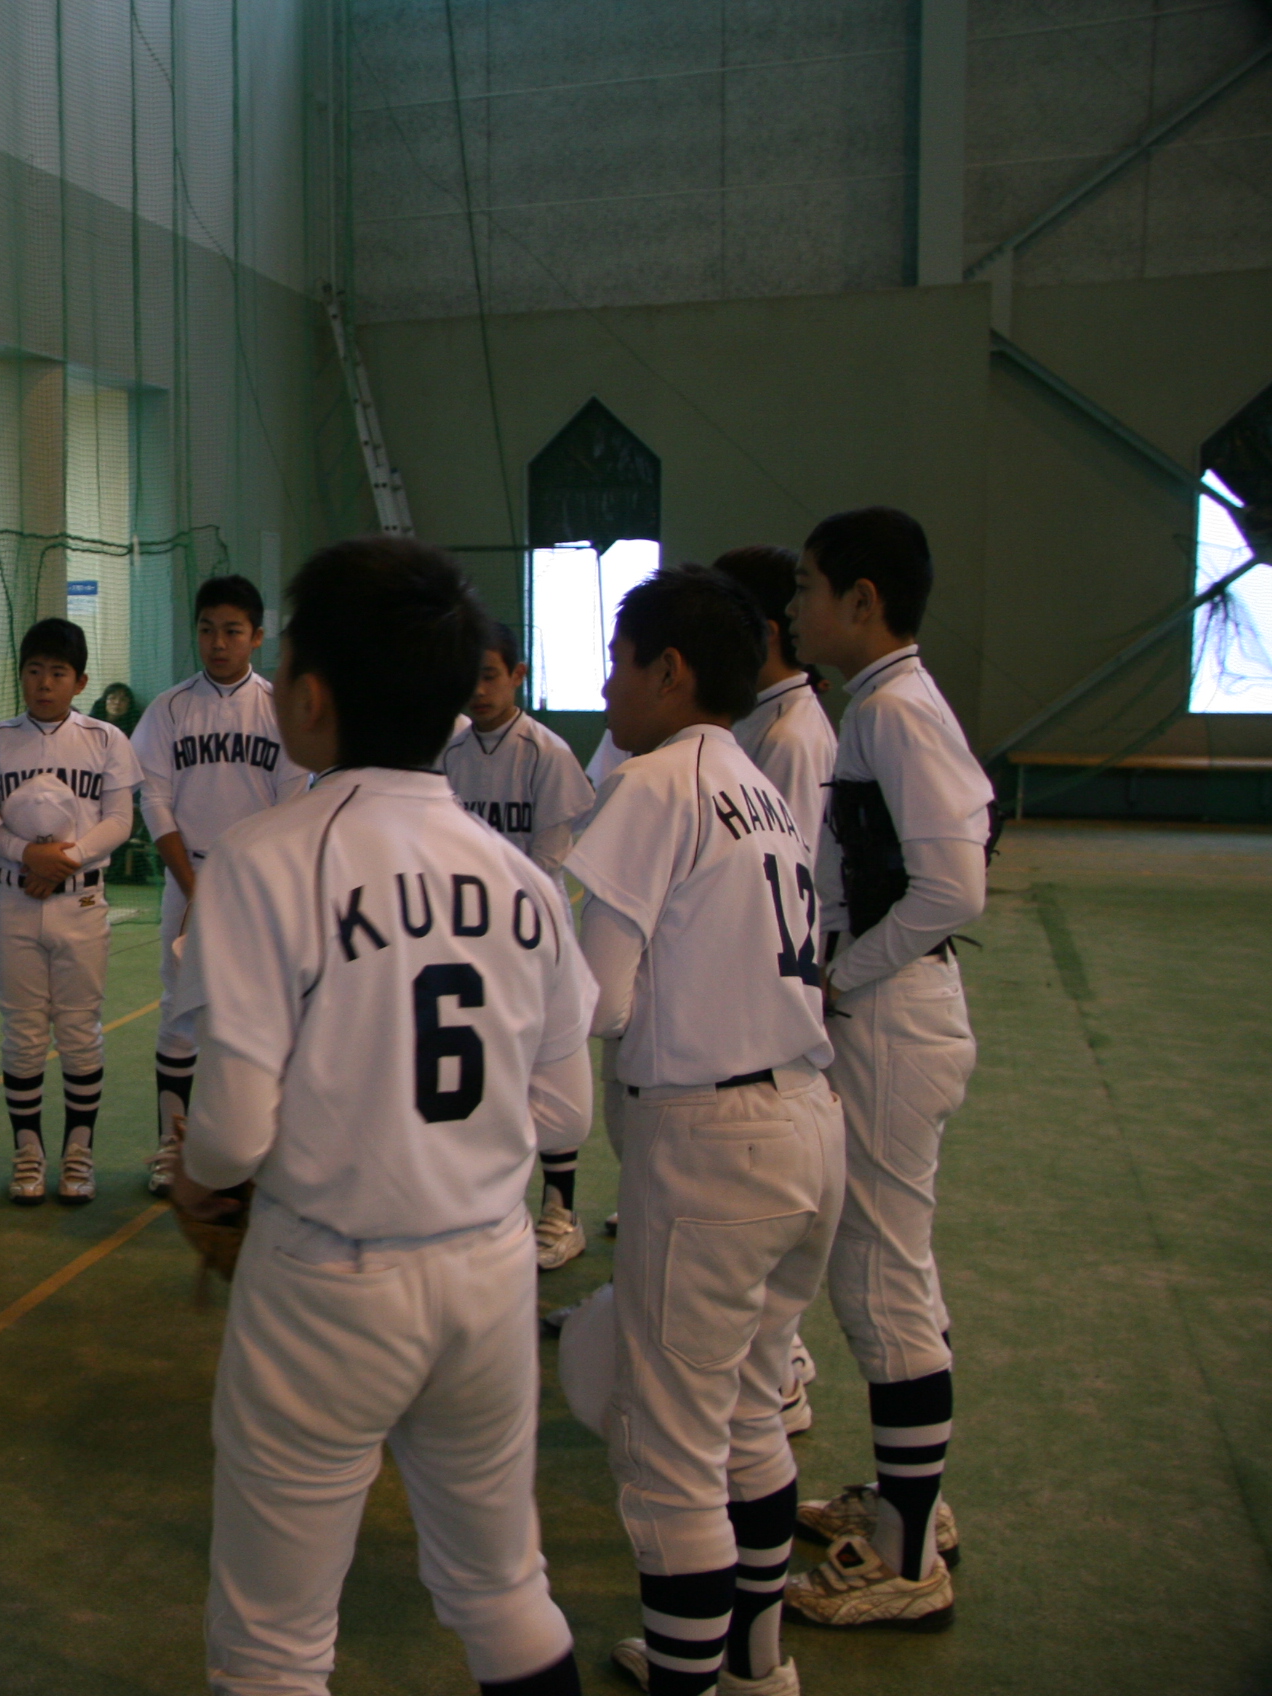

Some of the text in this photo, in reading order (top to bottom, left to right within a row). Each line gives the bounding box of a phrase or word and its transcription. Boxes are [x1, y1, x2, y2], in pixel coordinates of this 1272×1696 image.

[174, 733, 280, 772] HOKKAIDO
[712, 784, 811, 853] HAMA
[333, 873, 541, 962] KUDO
[763, 853, 821, 987] 12
[414, 963, 485, 1124] 6
